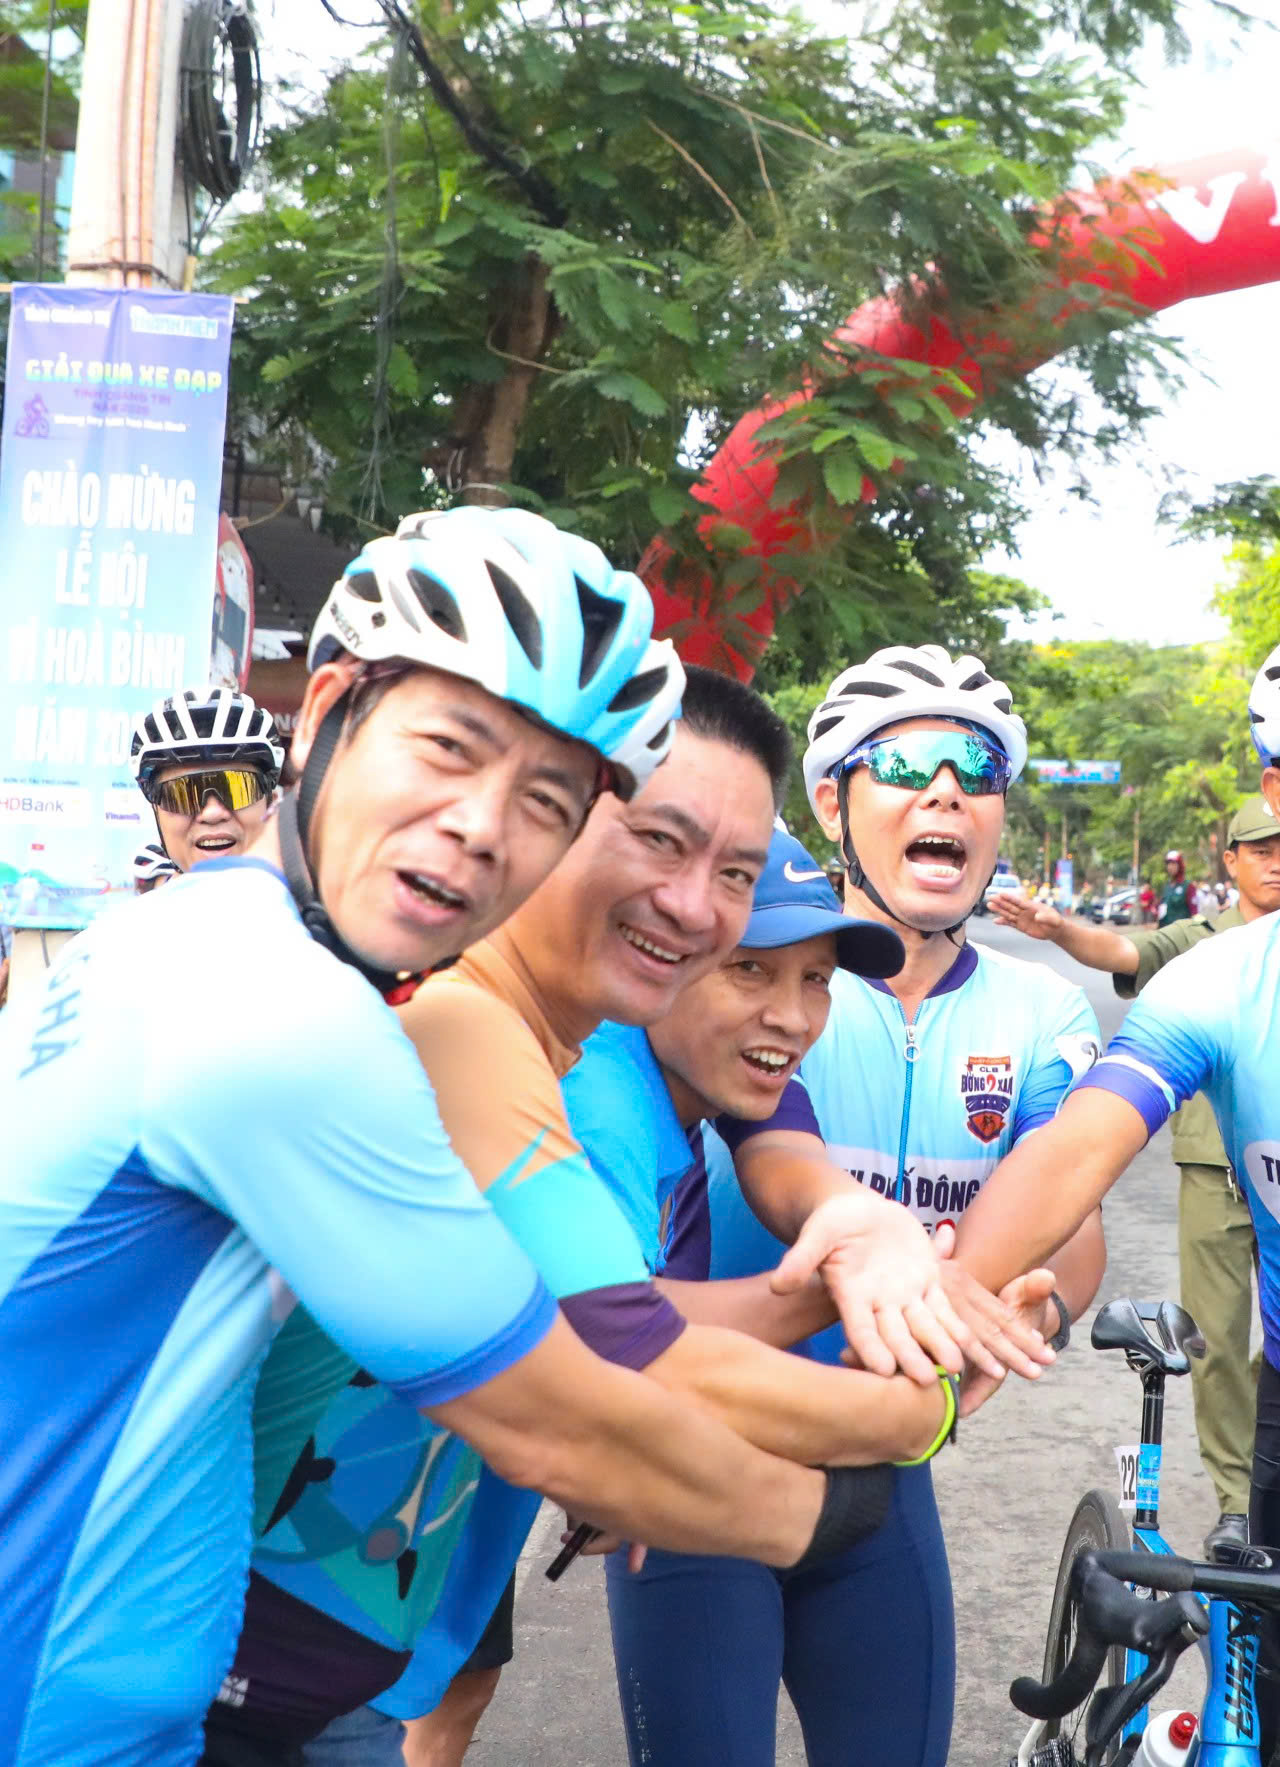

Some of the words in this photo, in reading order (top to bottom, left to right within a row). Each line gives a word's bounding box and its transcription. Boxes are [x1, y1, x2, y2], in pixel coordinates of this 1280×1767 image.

[139, 364, 169, 388] XE
[22, 459, 100, 527] CHÀO
[107, 464, 196, 535] MỪNG
[1121, 1454, 1140, 1501] 22
